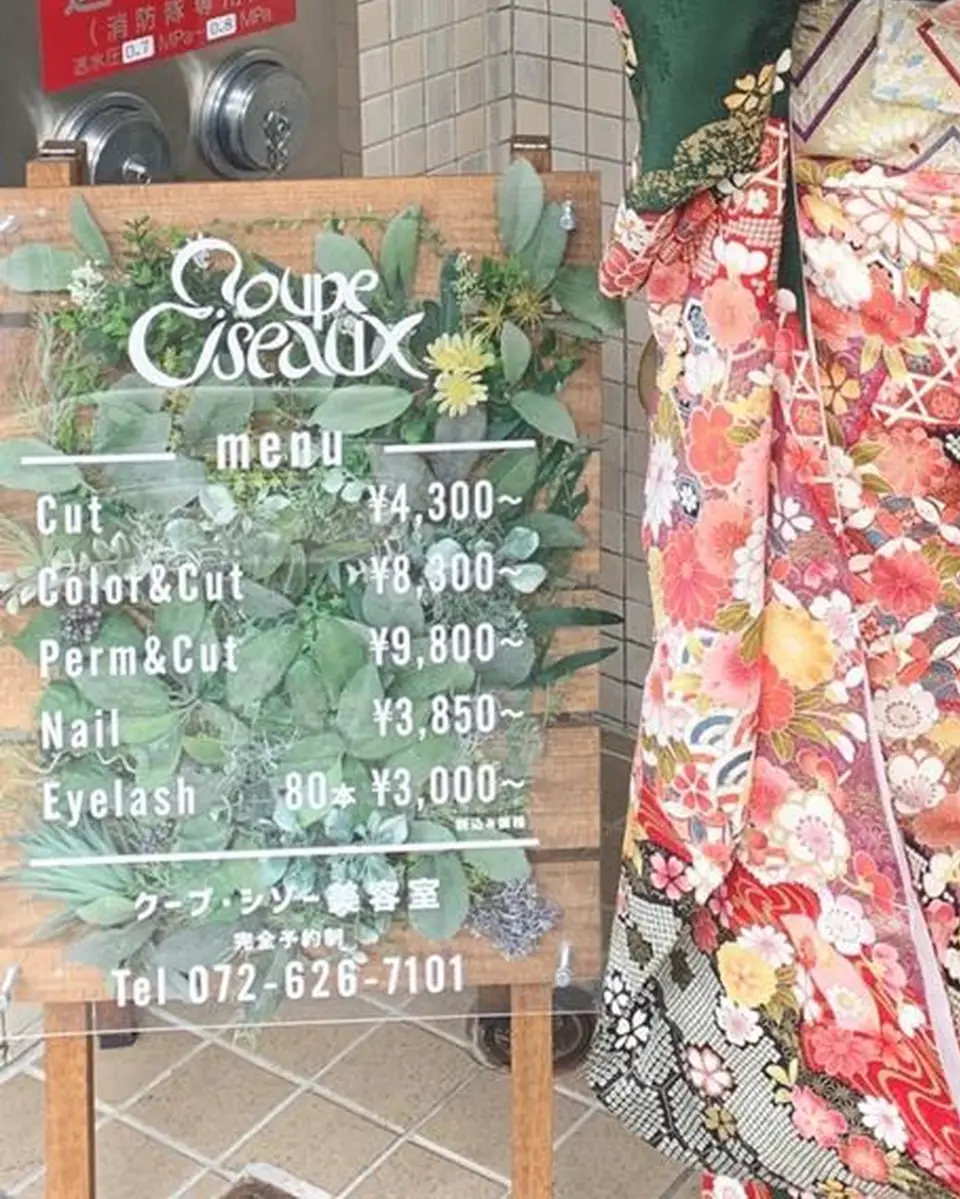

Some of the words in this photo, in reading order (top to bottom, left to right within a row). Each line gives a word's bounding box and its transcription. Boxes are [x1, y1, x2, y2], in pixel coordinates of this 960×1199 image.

[128, 302, 429, 388] Ciseaux
[217, 430, 343, 469] menu
[36, 495, 103, 535] Cut
[37, 563, 243, 607] Color&Cut
[39, 634, 239, 678] Perm&Cut
[41, 709, 120, 749] Nail
[42, 777, 196, 827] Eyelash
[111, 967, 166, 1008] Tel
[188, 954, 465, 1005] 072-626-7101
